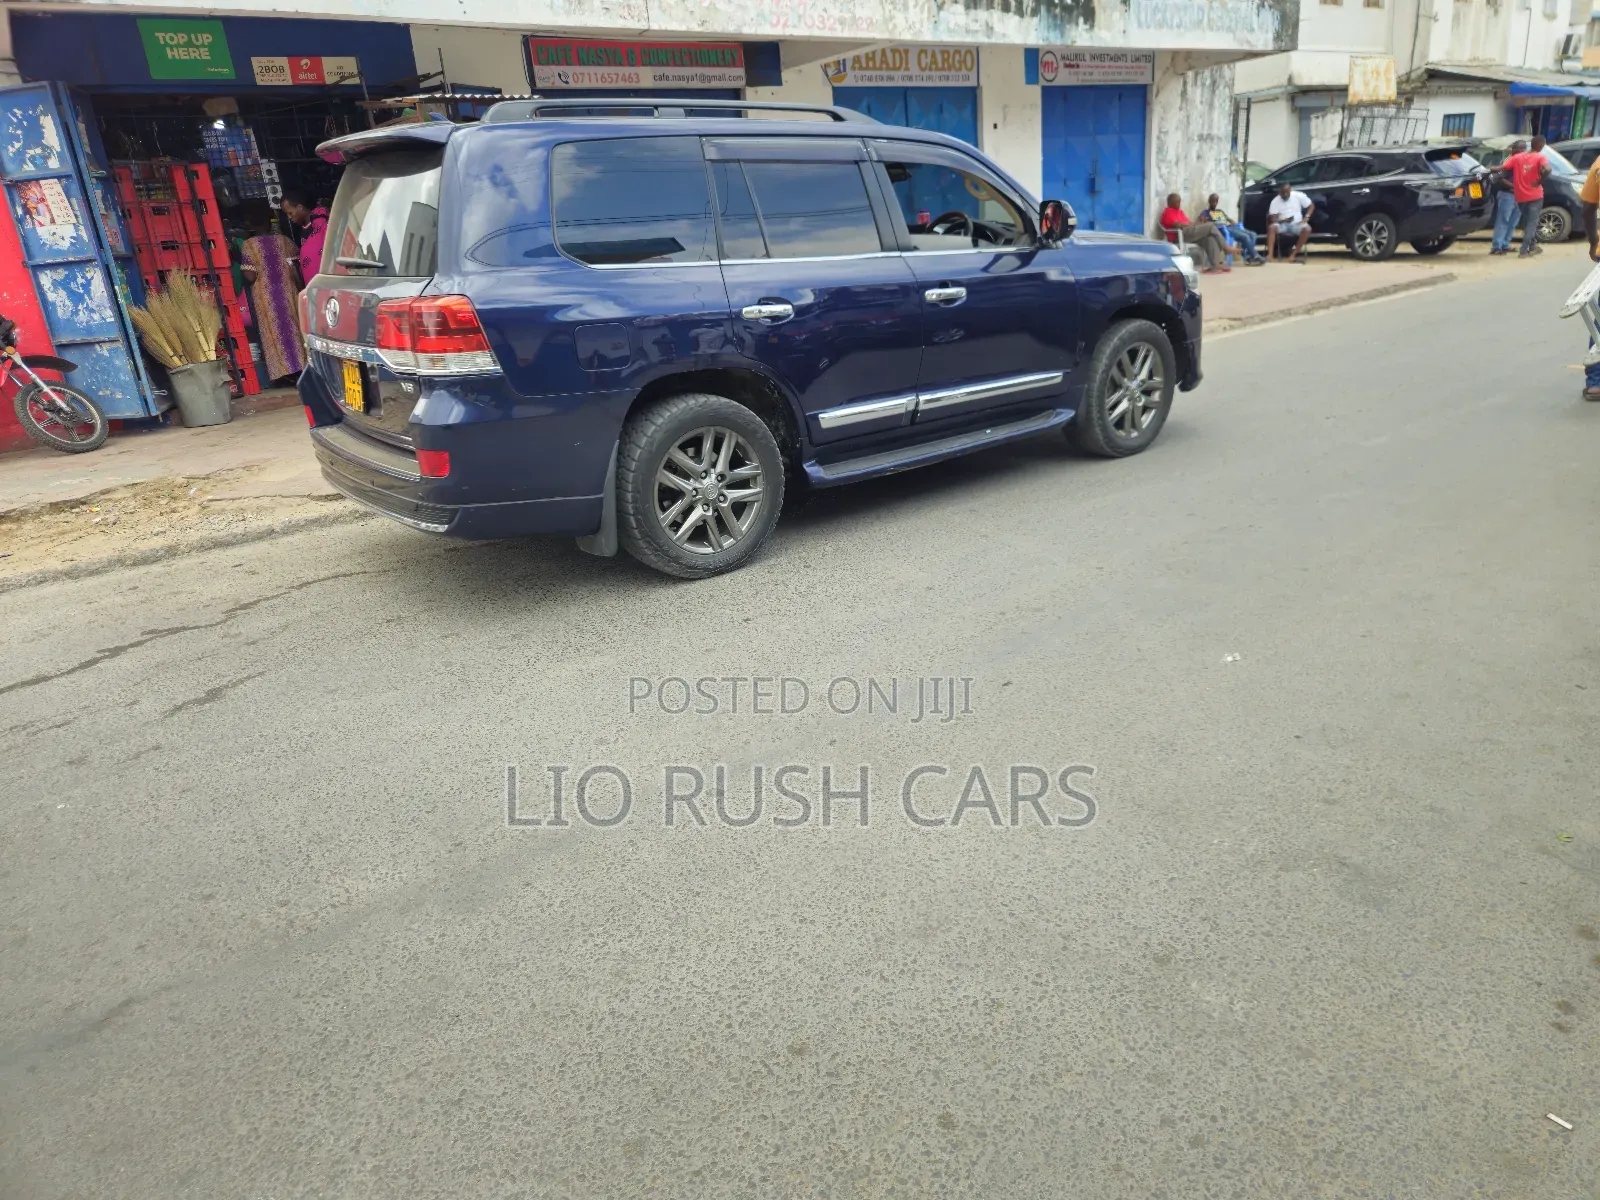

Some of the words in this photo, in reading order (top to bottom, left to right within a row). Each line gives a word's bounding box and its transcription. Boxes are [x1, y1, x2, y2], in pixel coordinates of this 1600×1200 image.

[155, 32, 189, 46] TOP
[191, 33, 213, 46] UP
[166, 47, 211, 60] HERE
[577, 46, 624, 66] NASYA
[641, 46, 740, 67] CONFECTIONERY
[1089, 53, 1128, 63] INVESTMENTS
[1130, 54, 1152, 63] LIMITED
[851, 48, 910, 71] AHADI
[917, 49, 975, 72] CARGO
[258, 65, 285, 74] 2BOB
[298, 71, 318, 80] airtel
[572, 71, 641, 84] 0711657463
[653, 72, 744, 83] cafe.nasya1@gmail.com
[400, 381, 413, 393] V8
